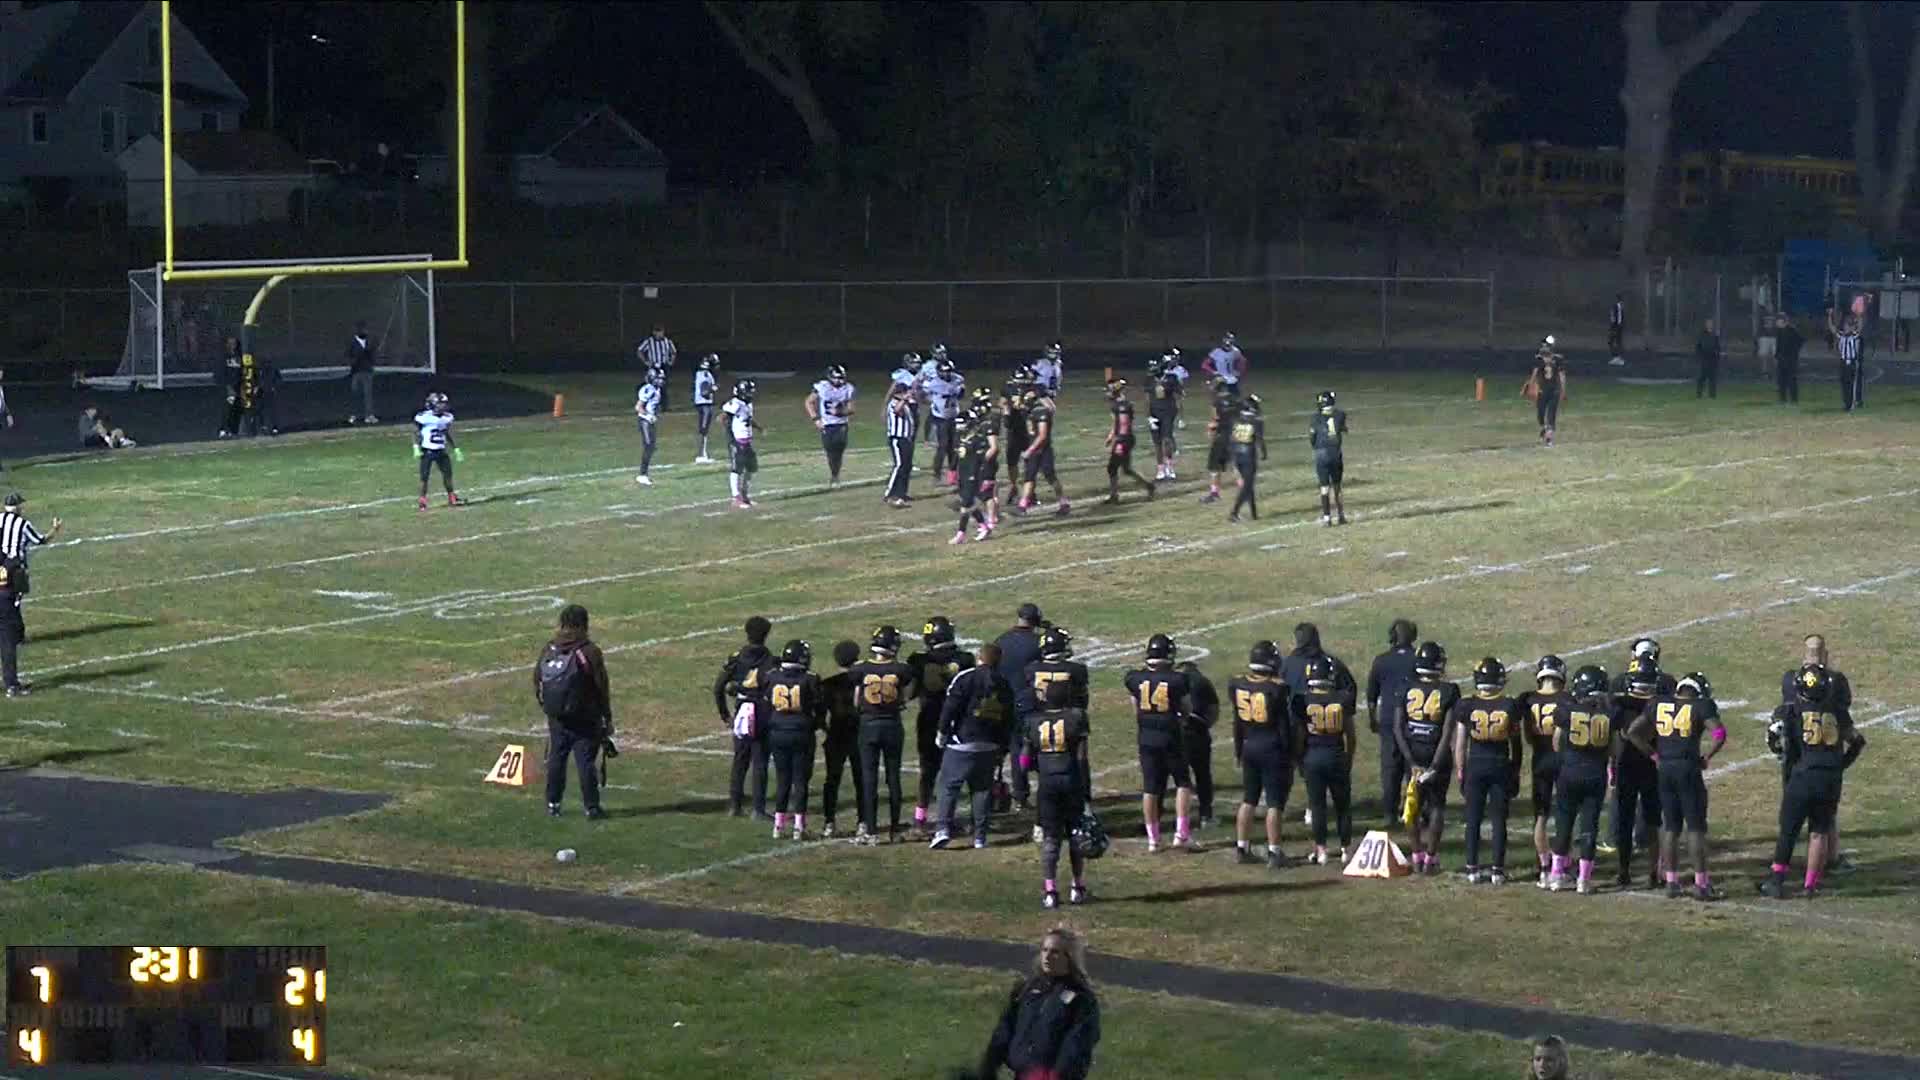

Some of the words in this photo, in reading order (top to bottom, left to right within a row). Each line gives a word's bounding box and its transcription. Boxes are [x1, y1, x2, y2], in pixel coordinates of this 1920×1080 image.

[771, 684, 801, 712] 61
[1138, 679, 1169, 713] 14
[1406, 687, 1441, 721] 24
[1038, 719, 1065, 752] 11
[1306, 703, 1344, 736] 30
[1470, 709, 1509, 742] 32
[1569, 711, 1611, 748] 50
[1655, 702, 1692, 737] 54
[496, 750, 522, 780] 20
[1358, 839, 1387, 870] 30
